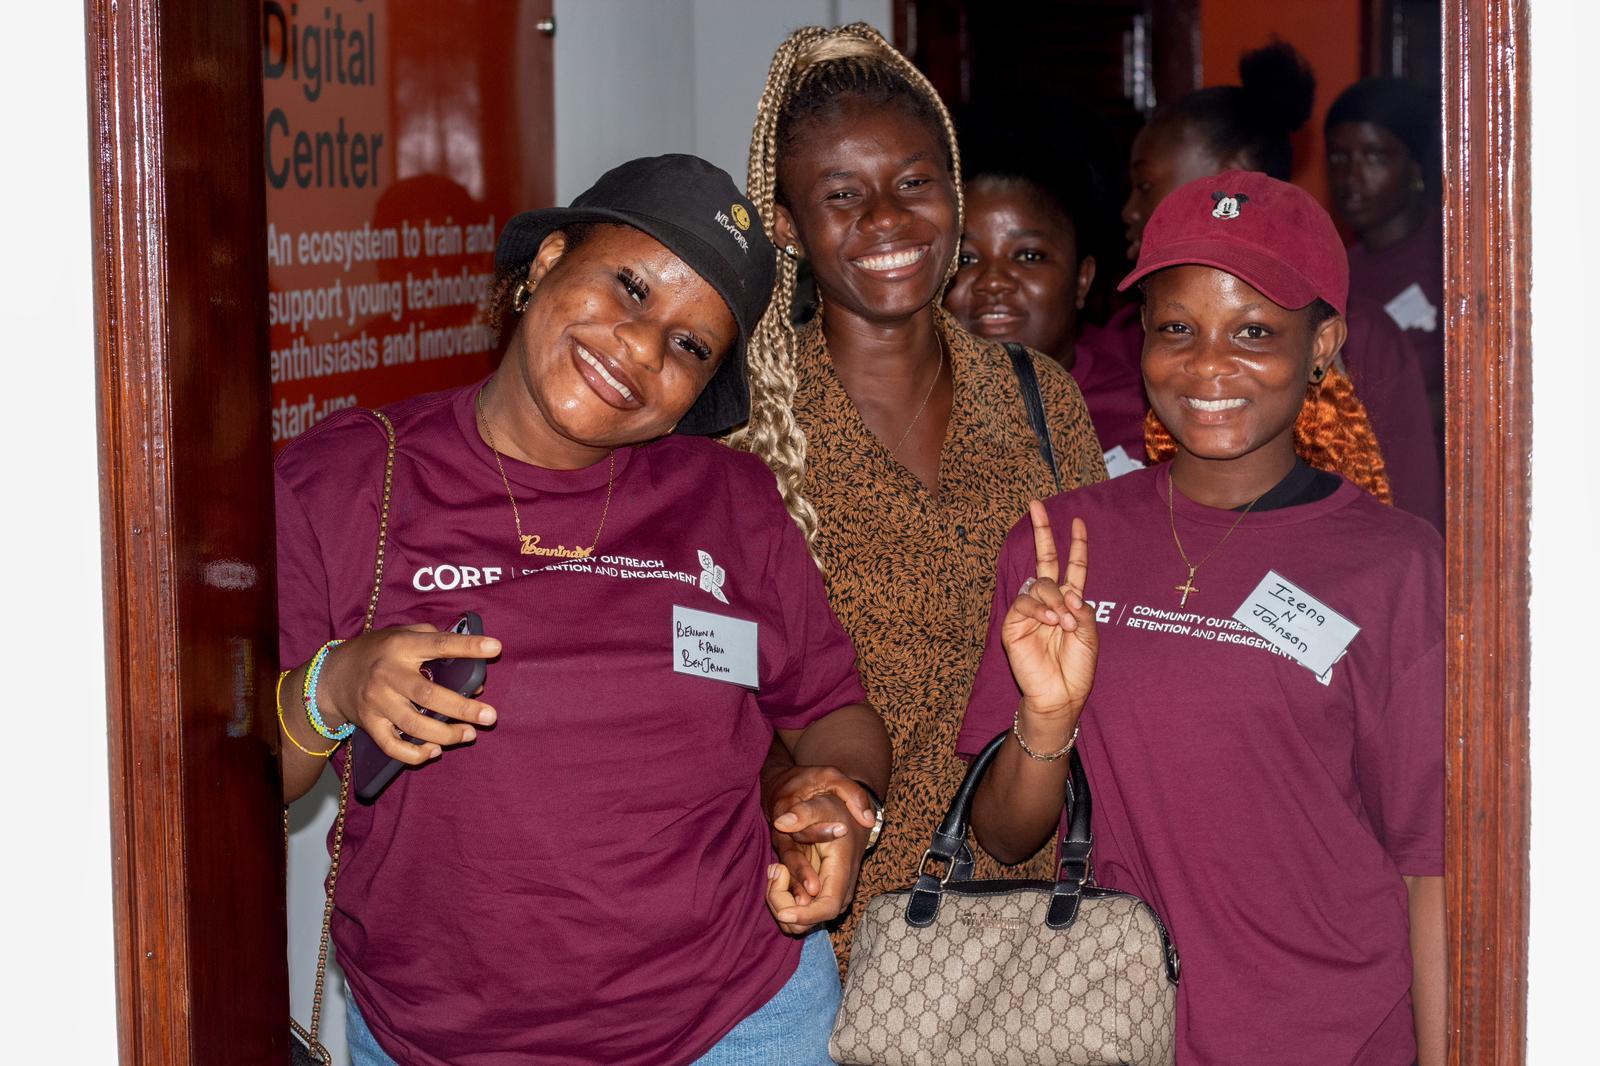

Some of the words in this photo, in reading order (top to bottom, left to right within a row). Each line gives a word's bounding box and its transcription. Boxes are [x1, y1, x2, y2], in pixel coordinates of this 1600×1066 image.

[263, 0, 375, 100] Digital
[264, 108, 384, 190] Center
[267, 222, 293, 267] An
[299, 222, 398, 271] ecosystem
[403, 220, 420, 257] to
[424, 216, 463, 257] train
[466, 214, 495, 254] and
[269, 277, 343, 333] support
[347, 279, 402, 322] young
[407, 265, 490, 310] technolog
[271, 330, 378, 384] enthusiasts
[383, 322, 415, 367] and
[595, 566, 619, 578] AND
[620, 569, 698, 586] ENGAGEMENT
[600, 555, 665, 569] OUTREACH
[1126, 617, 1192, 636] RETENTION
[1191, 629, 1217, 641] AND
[1132, 605, 1206, 625] COMMUNITY
[1253, 603, 1309, 653] Johnson
